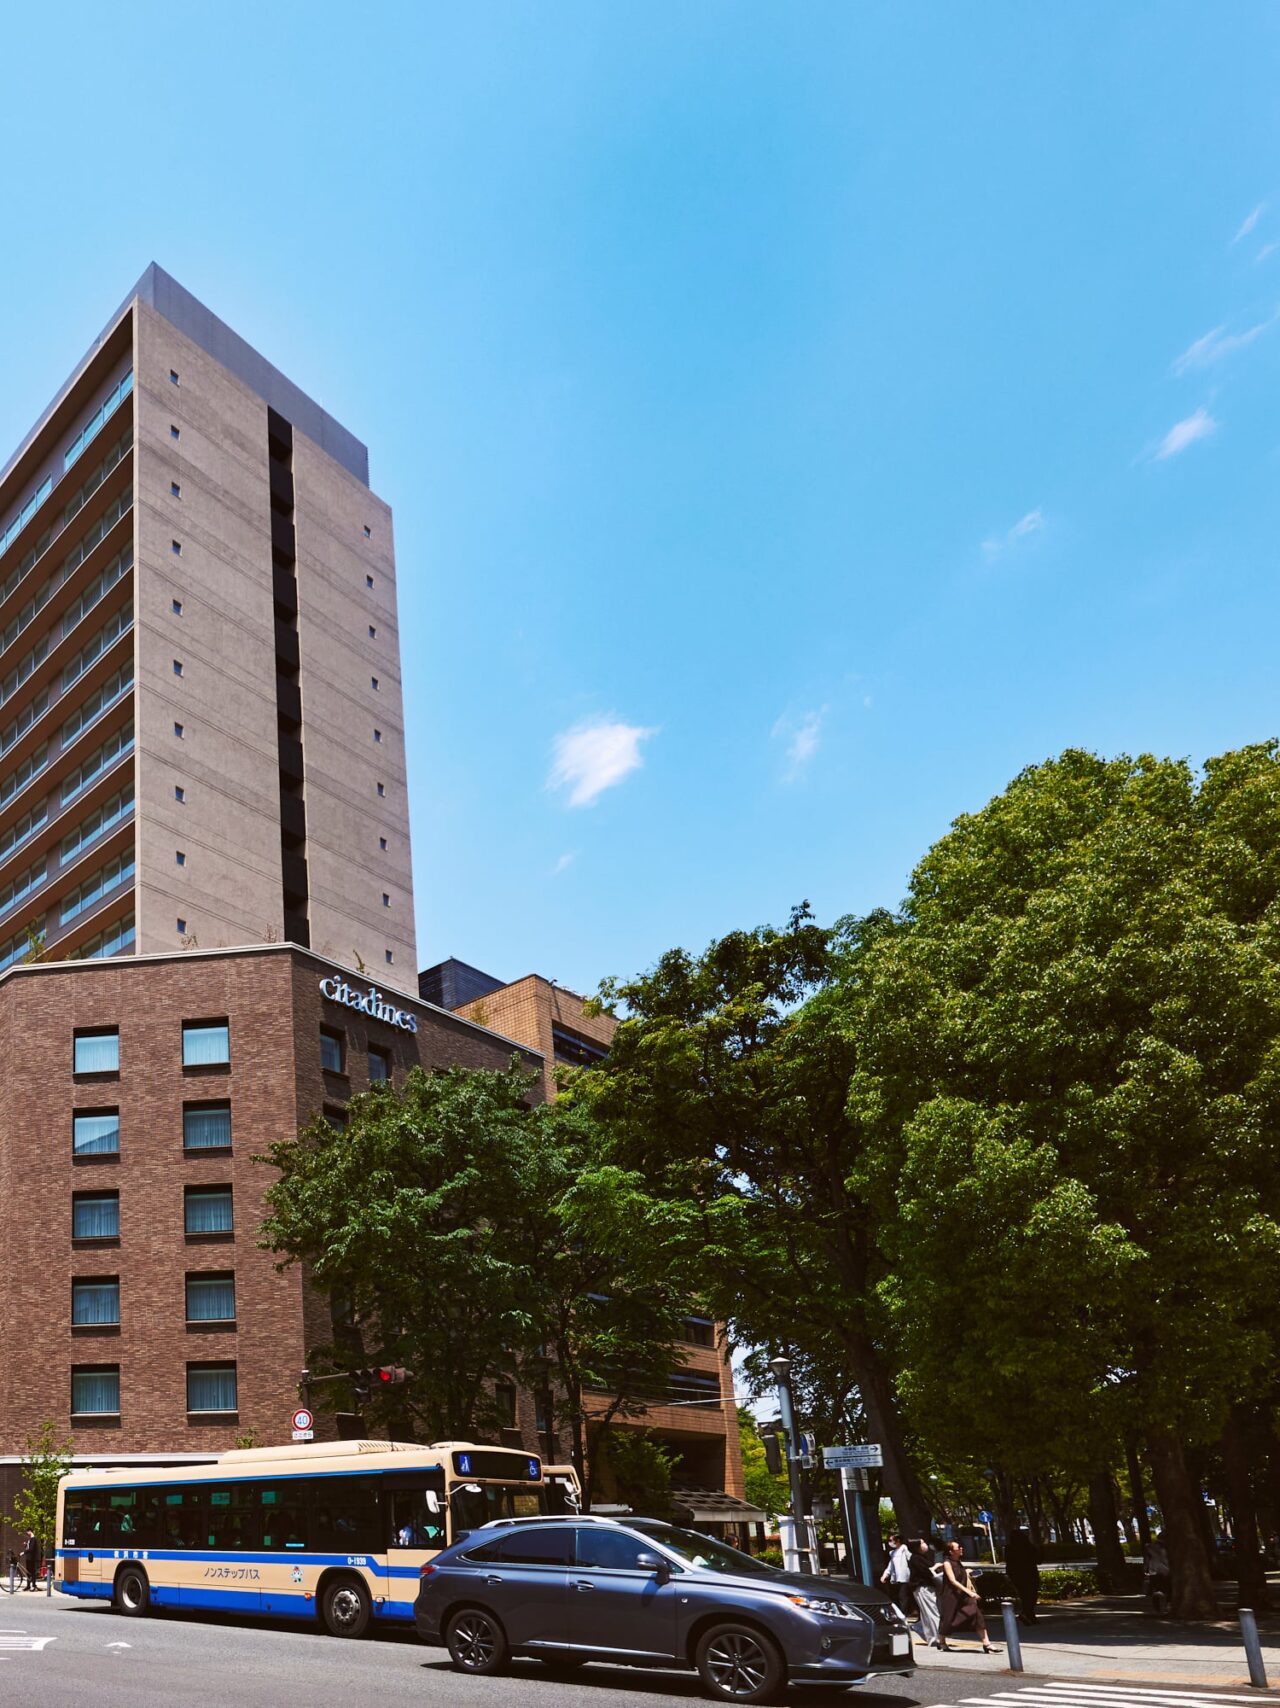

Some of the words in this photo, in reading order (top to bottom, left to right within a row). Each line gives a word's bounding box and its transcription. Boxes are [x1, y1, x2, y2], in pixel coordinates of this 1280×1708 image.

[319, 975, 417, 1033] citadines
[297, 1415, 308, 1424] 40
[204, 1567, 260, 1580] ノンステップバス
